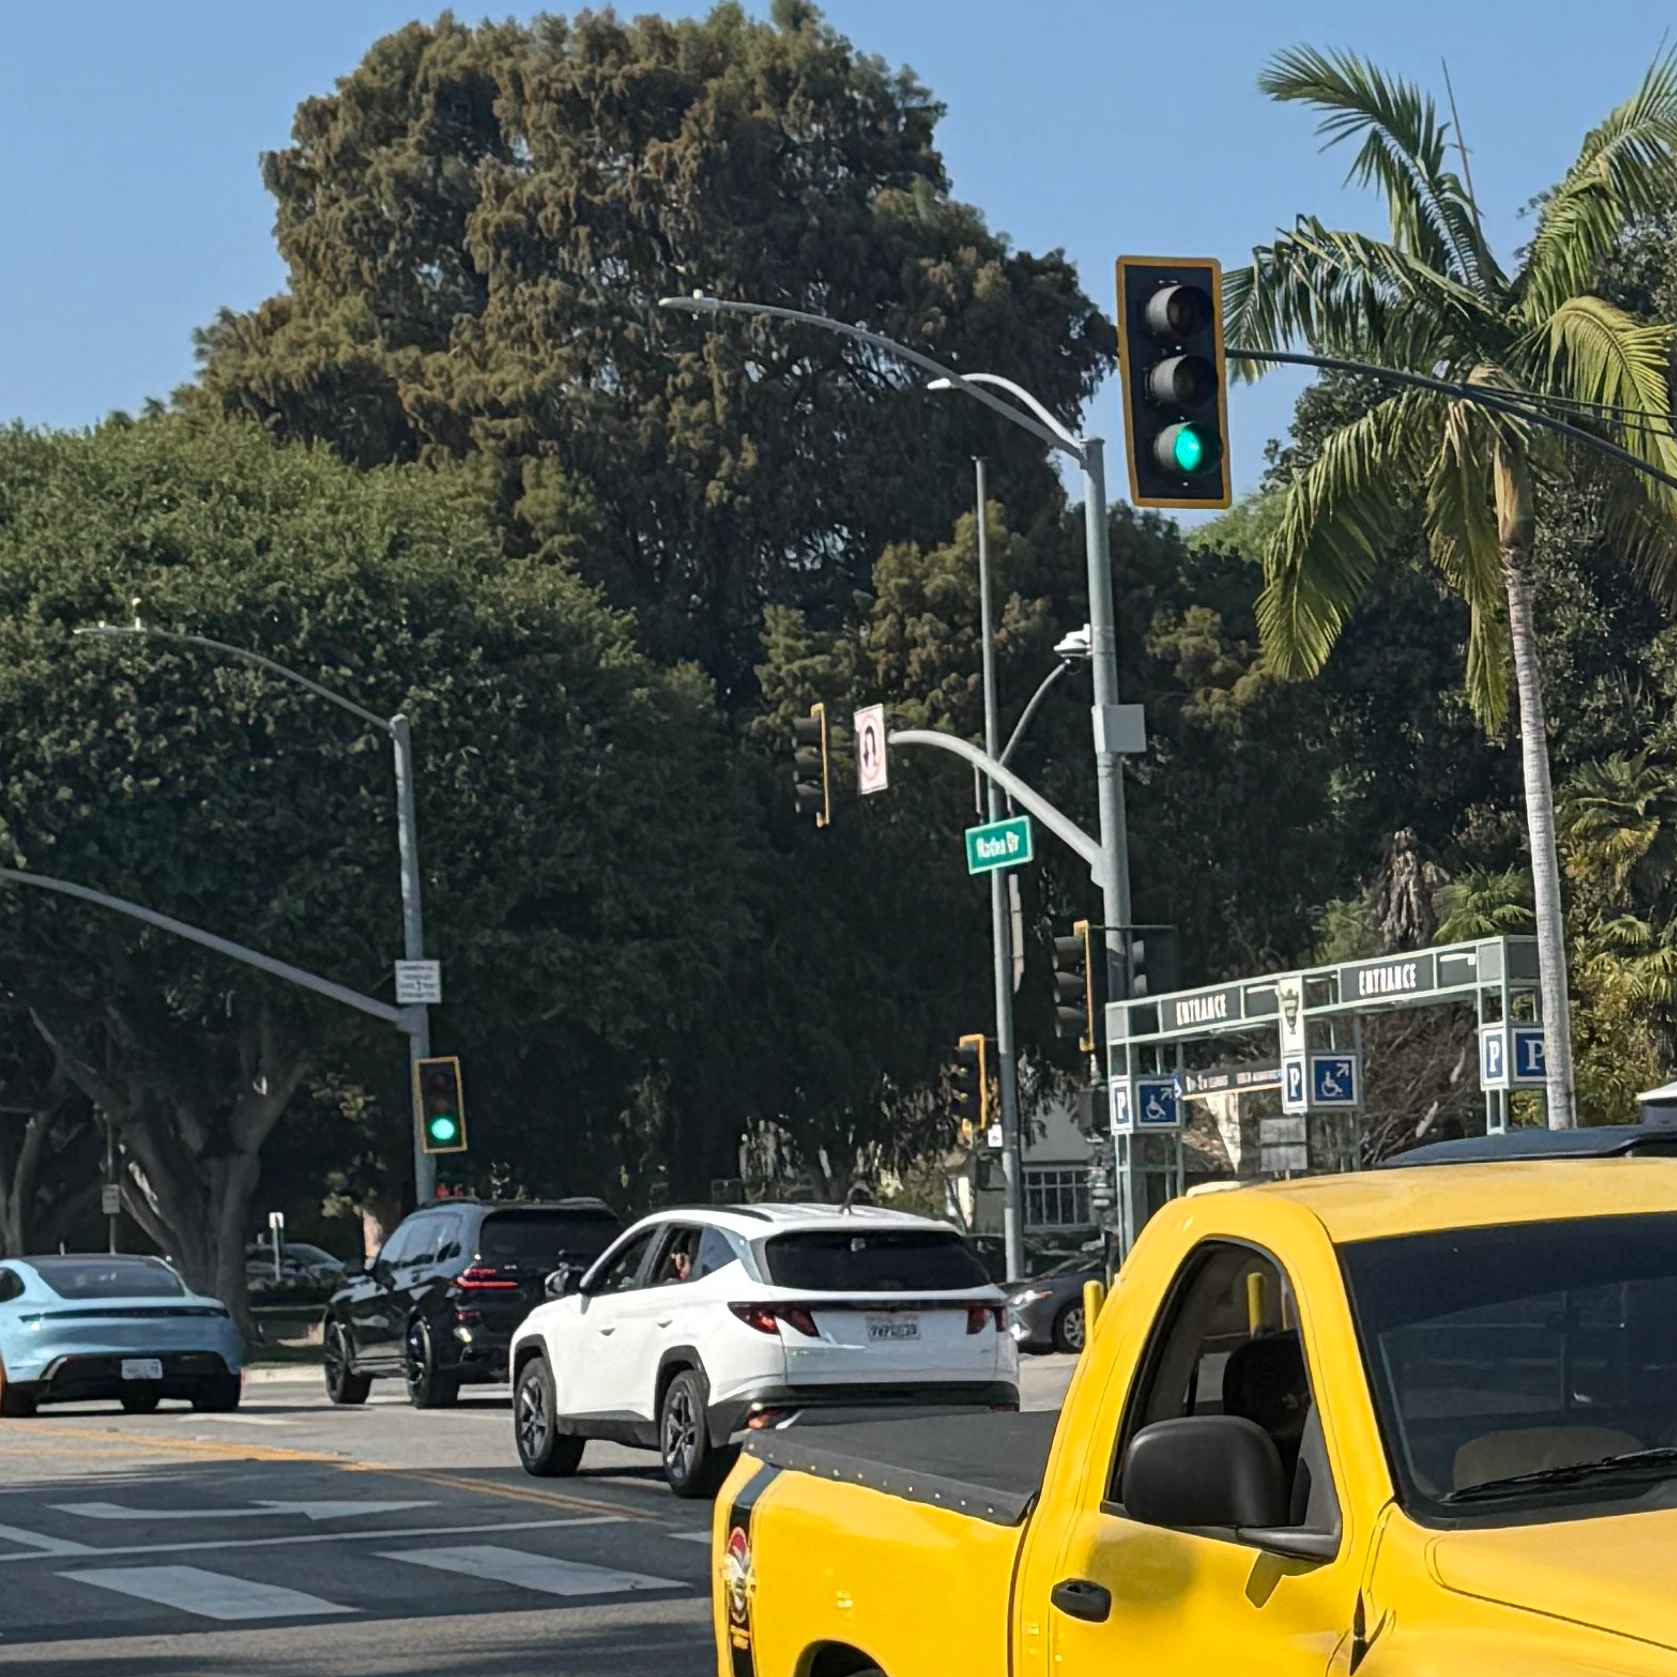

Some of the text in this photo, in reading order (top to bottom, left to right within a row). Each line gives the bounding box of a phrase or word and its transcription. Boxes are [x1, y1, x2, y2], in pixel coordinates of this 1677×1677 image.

[1358, 963, 1417, 996] ENTRANCE
[1489, 1040, 1499, 1073] P
[1525, 1039, 1545, 1071] P
[1289, 1066, 1300, 1098] P
[1116, 1090, 1127, 1119] P
